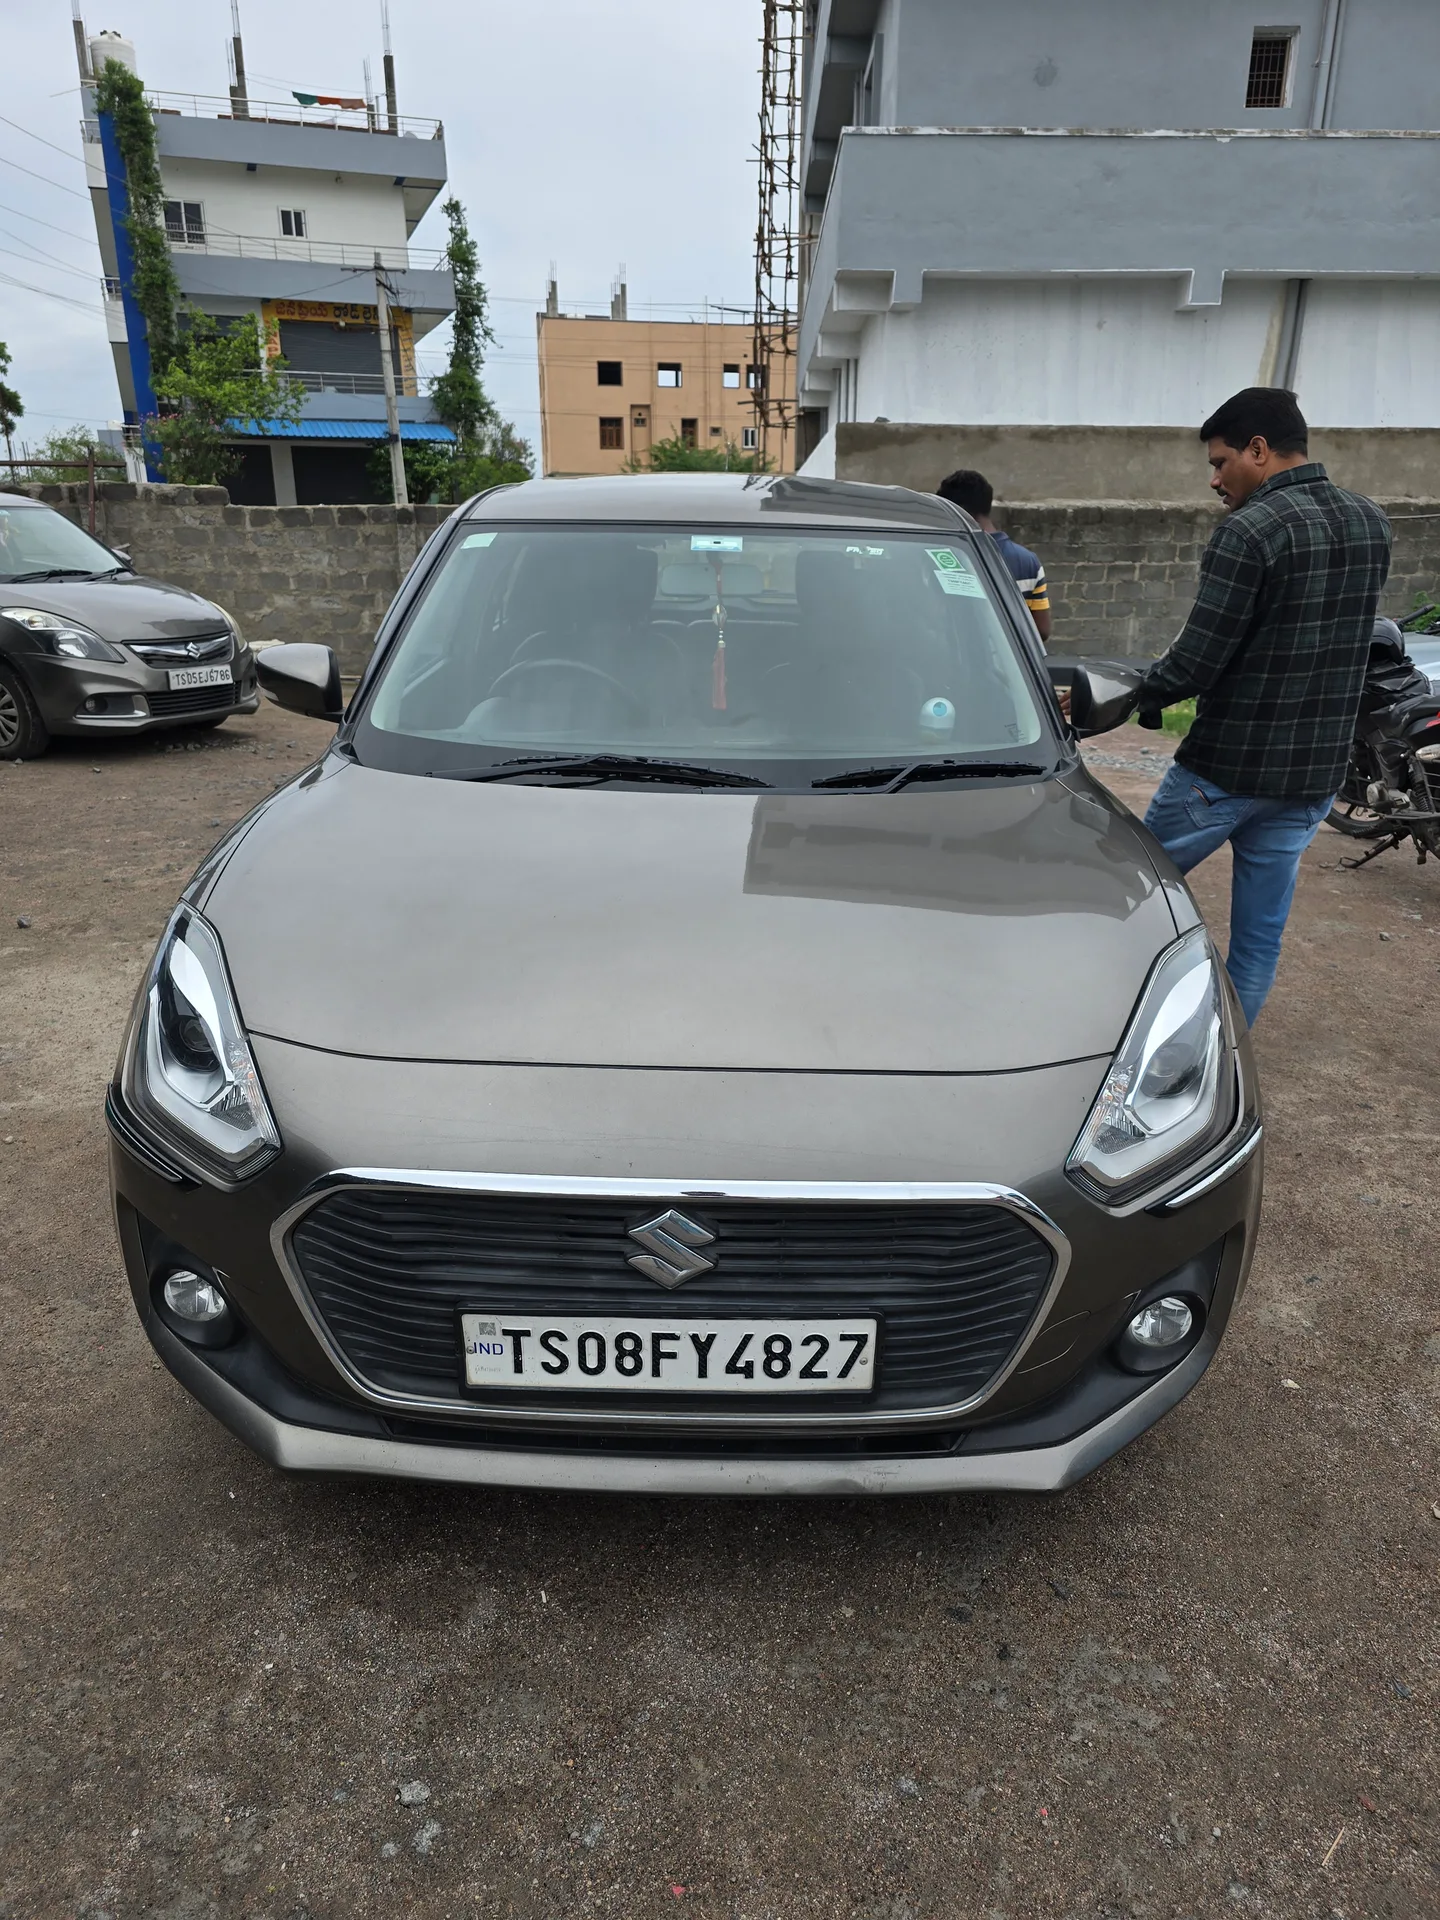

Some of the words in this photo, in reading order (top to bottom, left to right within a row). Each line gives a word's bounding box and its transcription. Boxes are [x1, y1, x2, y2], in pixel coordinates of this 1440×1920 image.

[175, 669, 230, 686] TS05EJ6786
[473, 1342, 504, 1355] IND
[502, 1328, 868, 1379] TS08FY4827
